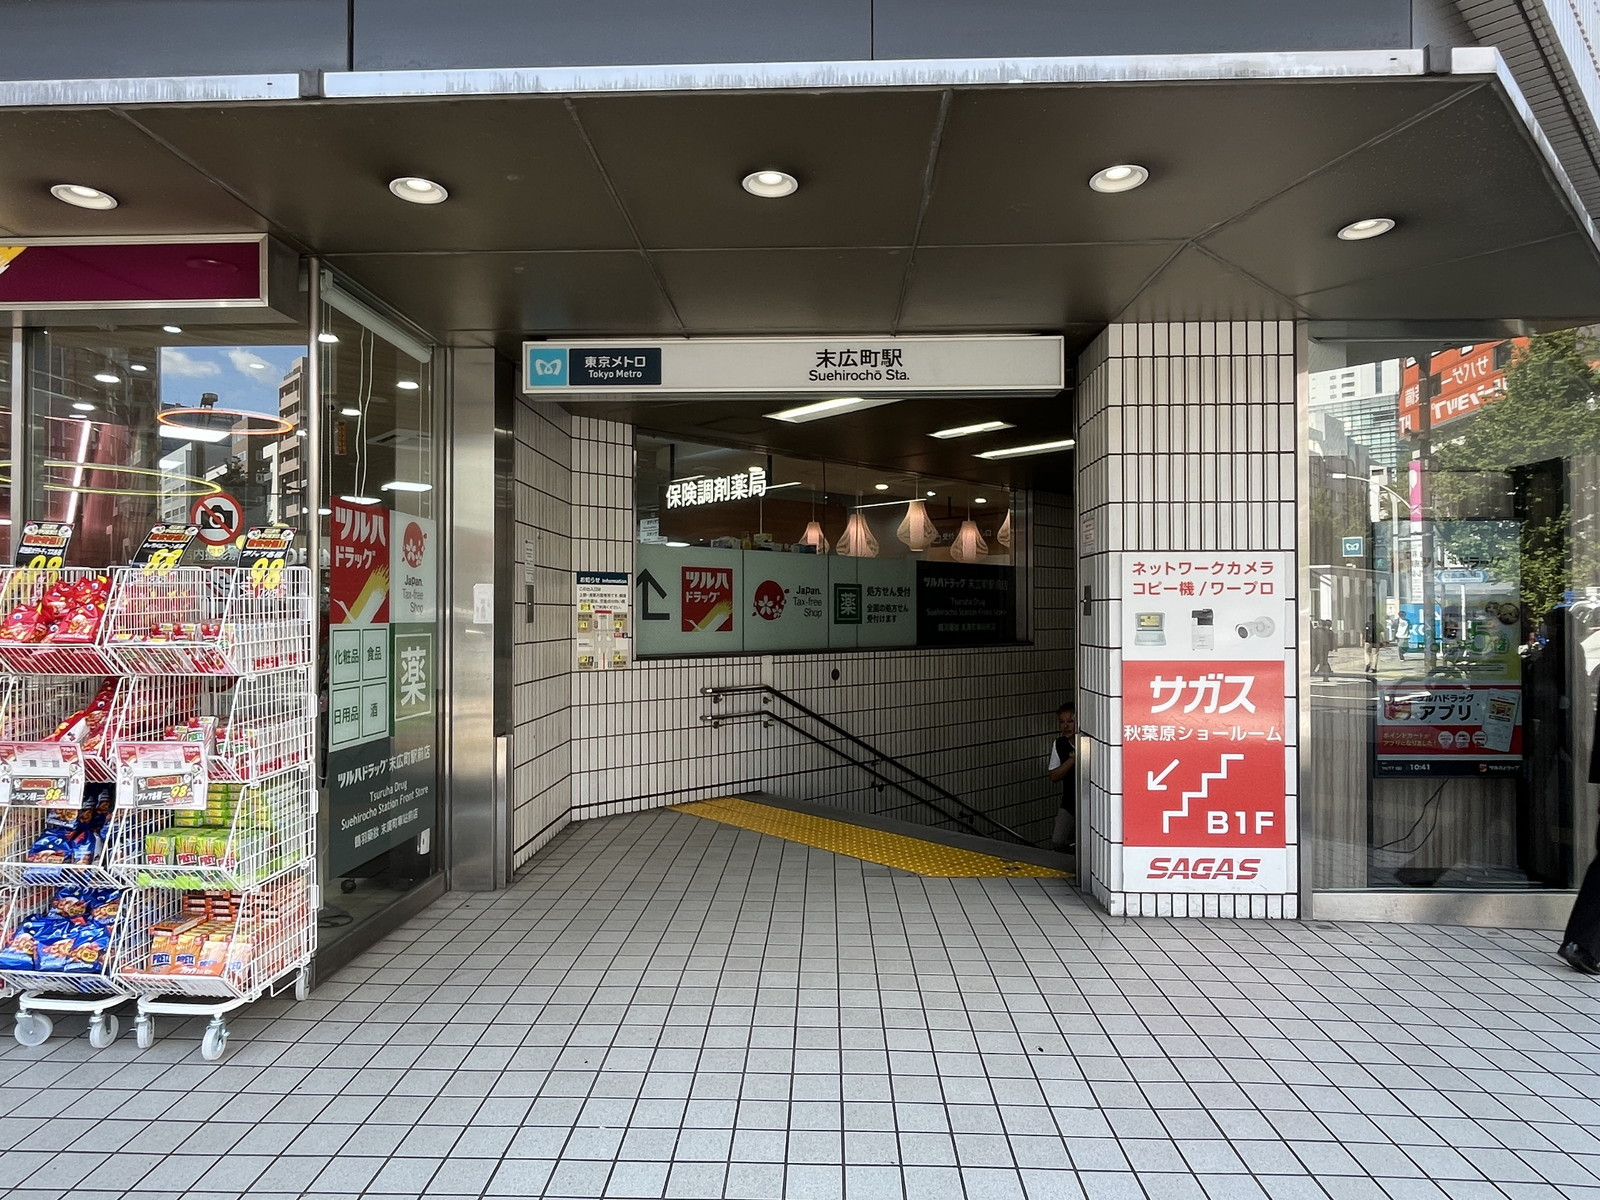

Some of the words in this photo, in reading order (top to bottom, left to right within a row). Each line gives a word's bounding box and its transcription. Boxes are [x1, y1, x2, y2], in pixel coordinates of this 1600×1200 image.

[585, 356, 646, 368] 東京メトロ
[816, 348, 904, 368] 末広町駅
[588, 369, 614, 380] Tokyo
[616, 369, 642, 379] Metro
[886, 369, 911, 381] Sta.
[666, 471, 767, 509] 保険調剤薬局
[335, 506, 386, 547] ツルハ
[335, 545, 376, 570] ドラッグ
[1132, 561, 1274, 576] ネットワークカメラ
[685, 571, 730, 590] ツルハ
[402, 588, 423, 600] Tax-free
[685, 591, 721, 604] ドラッグ
[866, 586, 911, 597] 処方せん受付
[410, 602, 423, 615] Shop
[793, 597, 822, 607] Tax-free
[840, 592, 857, 615] 薬
[866, 603, 909, 613] 全国の処方せん
[804, 607, 822, 619] Shop
[866, 615, 897, 624] 受付けます
[335, 649, 359, 665] 化粧品
[367, 646, 382, 661] 食品
[401, 646, 426, 706] 薬
[1150, 673, 1256, 714] サガス
[334, 706, 359, 725] 日用品
[370, 702, 378, 717] 酒
[1420, 704, 1472, 721] アプリ
[1124, 725, 1282, 742] 秋葉原ショールーム
[338, 759, 388, 788] ツルハドラッグ
[389, 745, 430, 772] 末広町駅前店
[45, 788, 61, 800] 88
[170, 785, 188, 798] 98
[370, 786, 393, 802] Tsuruha
[394, 781, 407, 792] Drug
[341, 808, 377, 831] Suehirocho
[378, 798, 399, 814] Station
[400, 791, 414, 805] Front
[415, 786, 429, 798] Store
[1207, 811, 1275, 835] B1F
[178, 854, 196, 864] PRETZ
[1146, 857, 1262, 880] SAGAS
[152, 953, 170, 965] PRETZ
